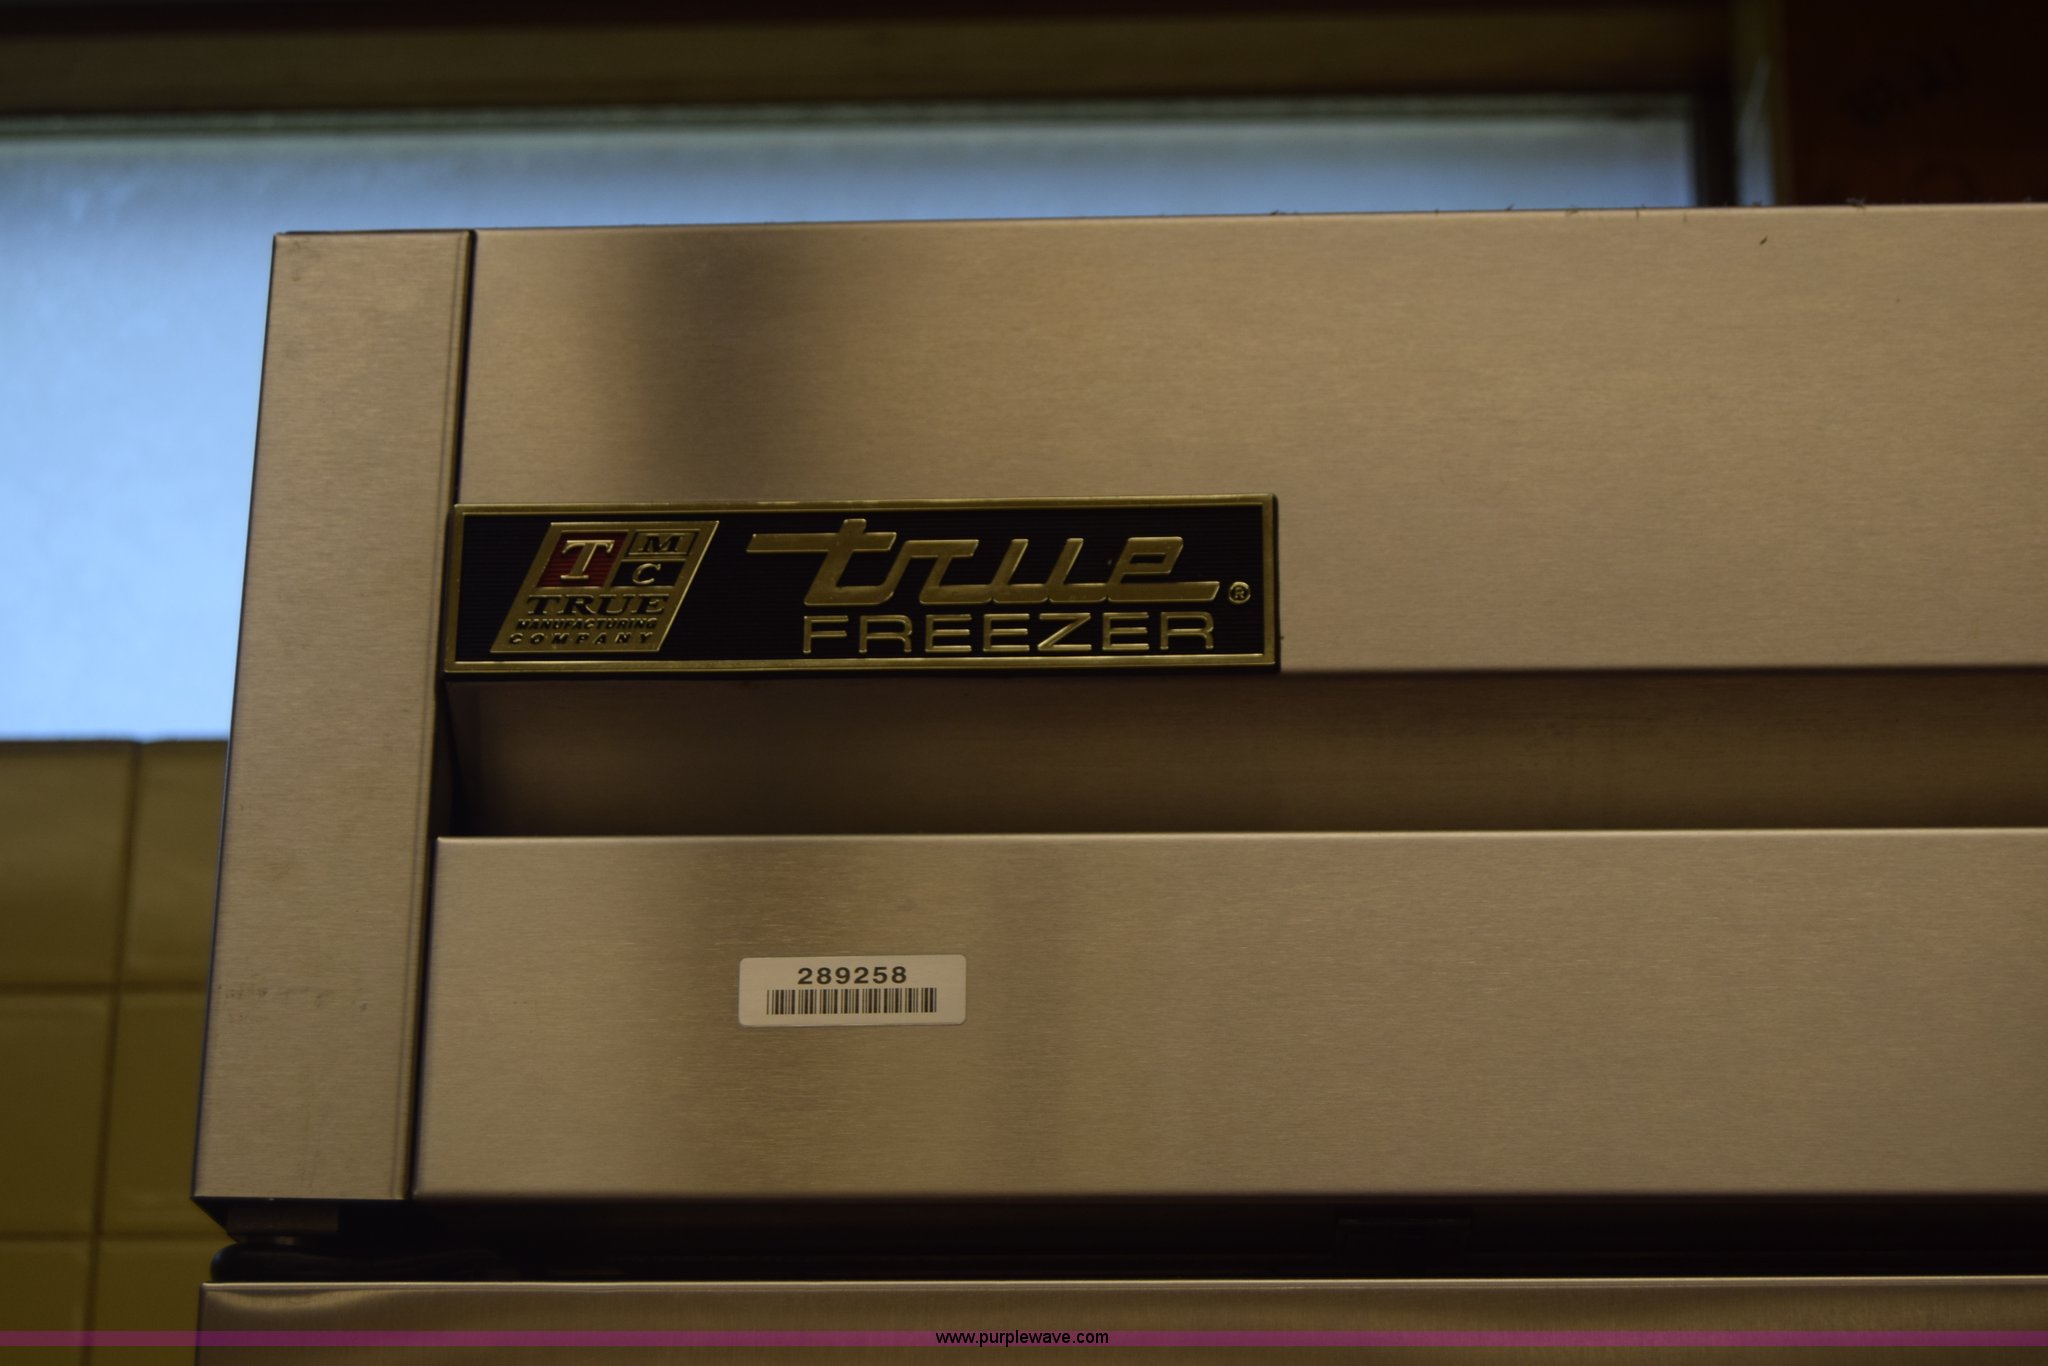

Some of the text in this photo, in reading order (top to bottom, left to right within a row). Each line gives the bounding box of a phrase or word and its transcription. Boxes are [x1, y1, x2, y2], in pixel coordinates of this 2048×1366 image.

[638, 533, 686, 553] M
[561, 539, 615, 580] T
[632, 563, 661, 585] C
[526, 593, 670, 616] TRUE
[515, 617, 658, 631] MANUFACTURING
[803, 610, 1215, 654] FREEZER
[508, 632, 654, 646] COMPANY
[797, 966, 908, 985] 289258
